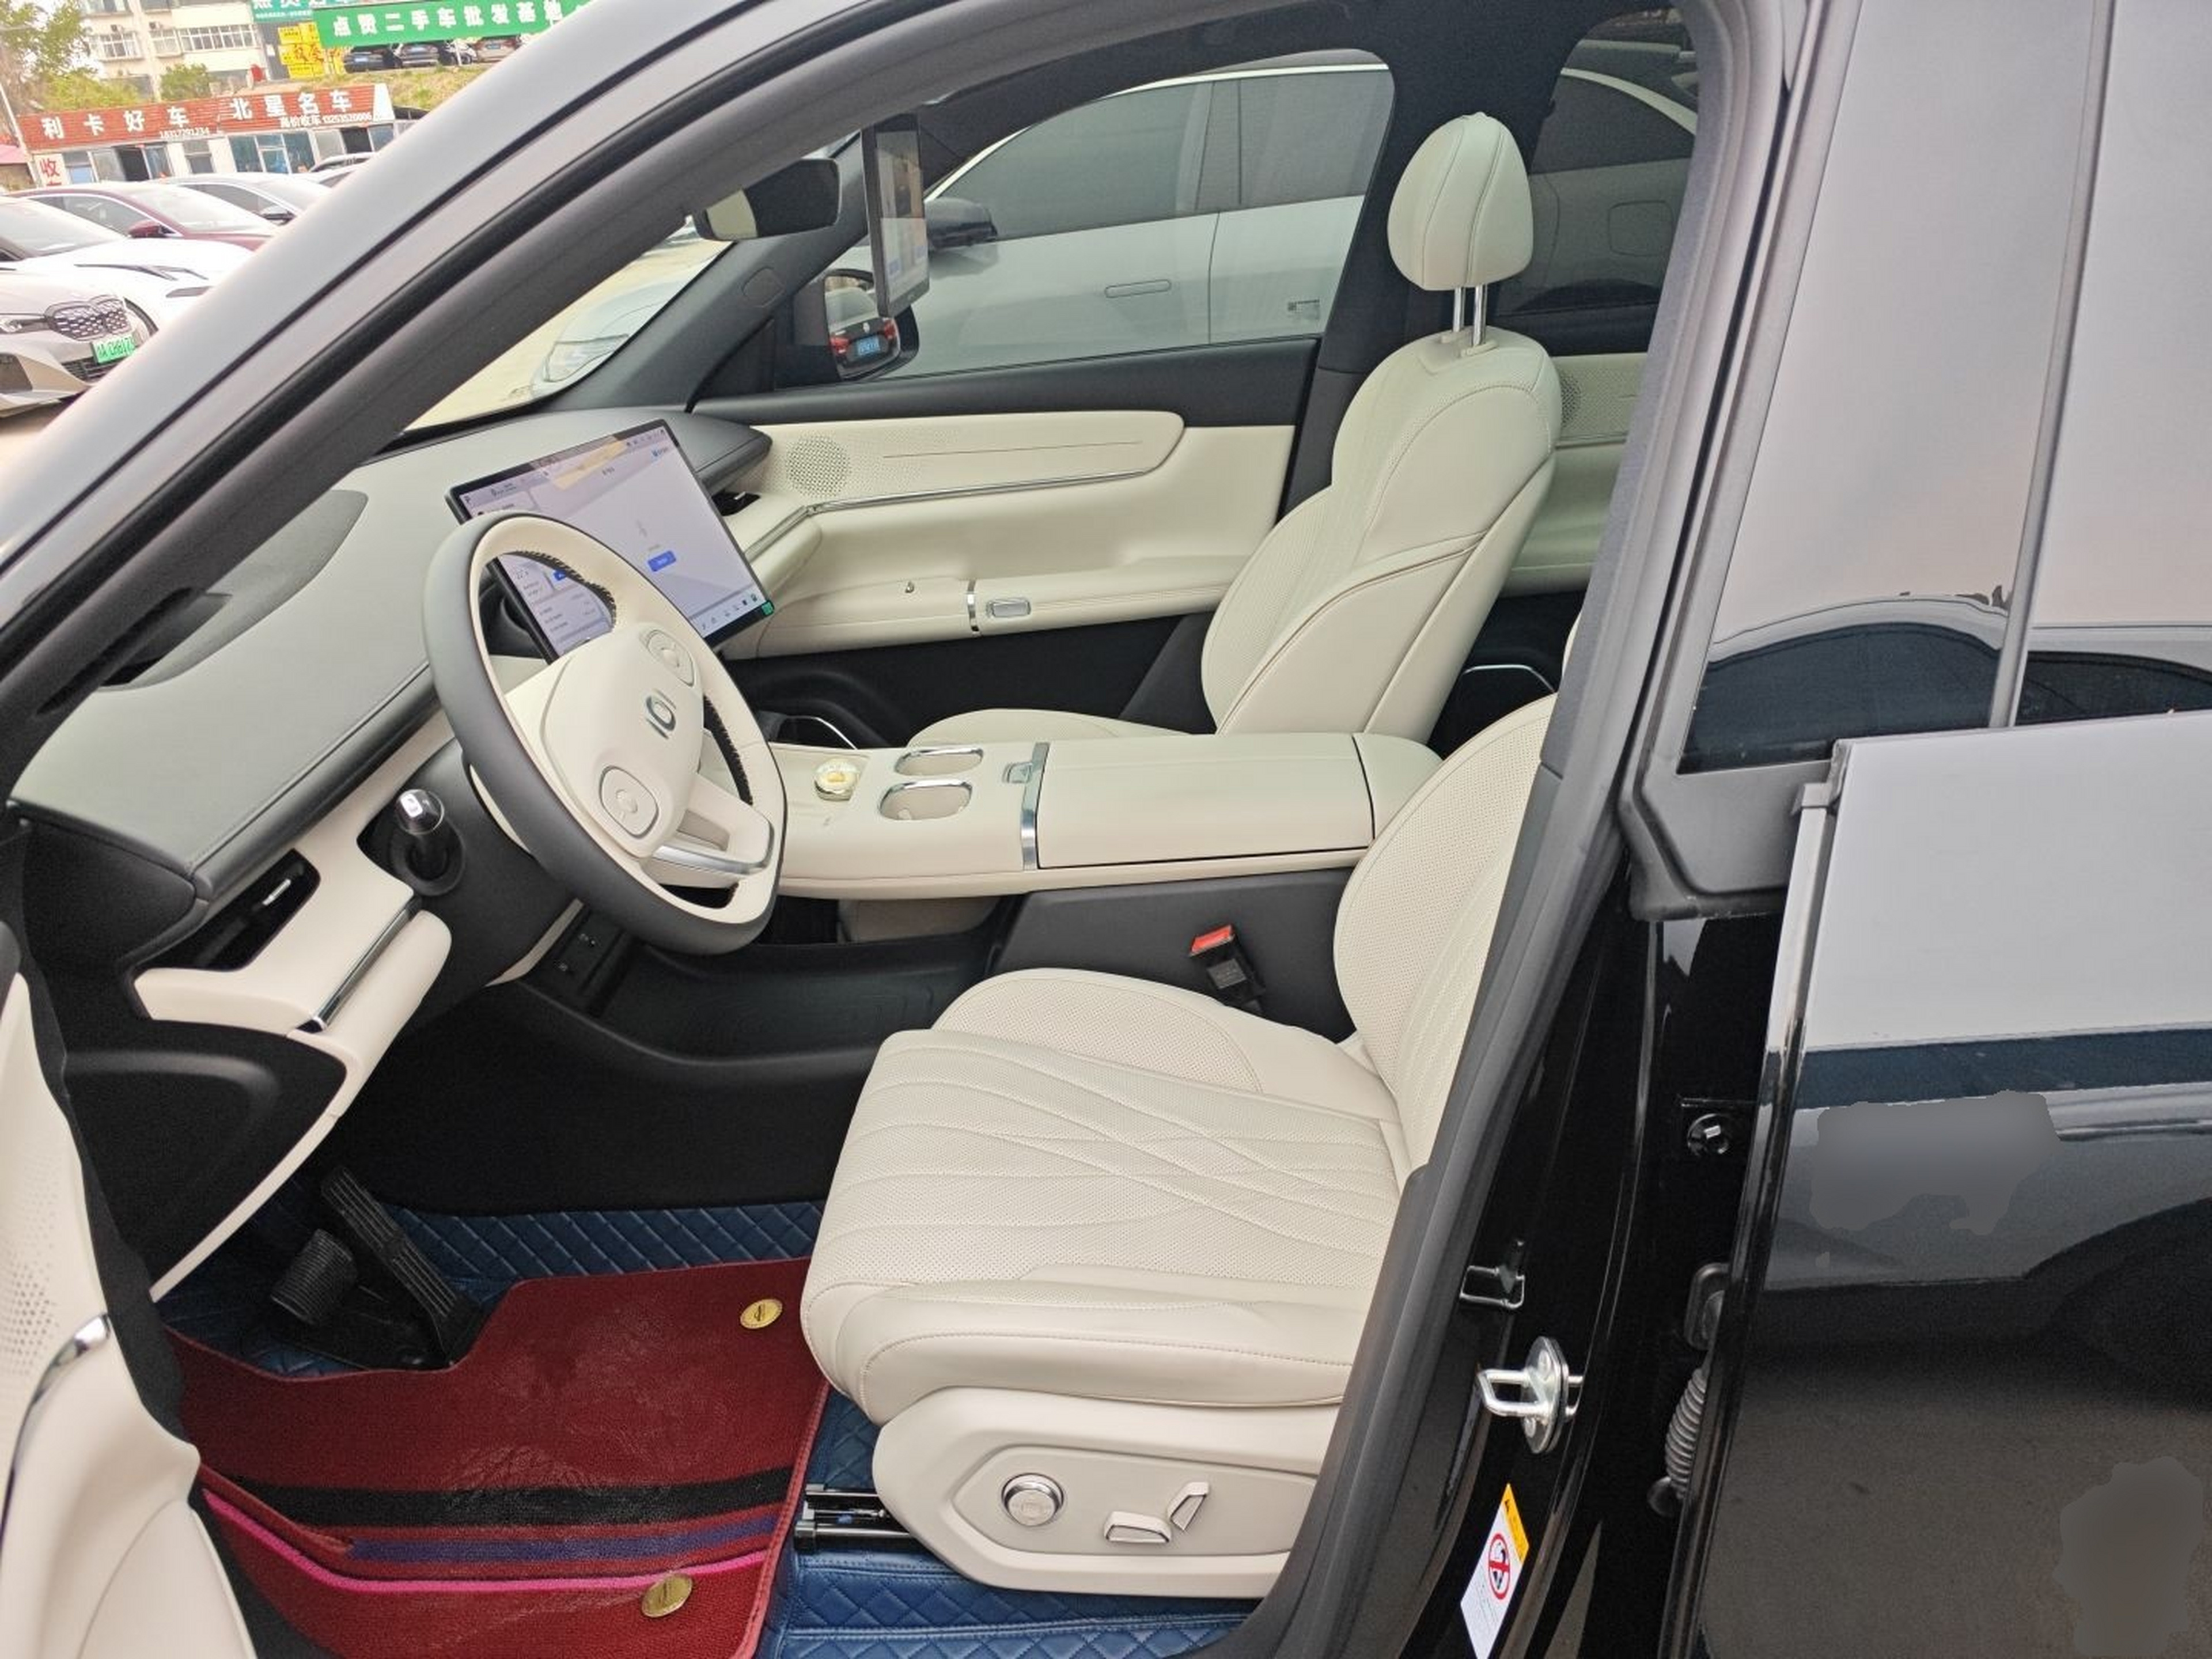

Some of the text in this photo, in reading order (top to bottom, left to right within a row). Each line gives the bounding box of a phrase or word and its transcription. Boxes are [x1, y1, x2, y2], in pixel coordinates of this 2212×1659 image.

[230, 89, 353, 120] 北星名车
[40, 106, 190, 139] 利卡好车
